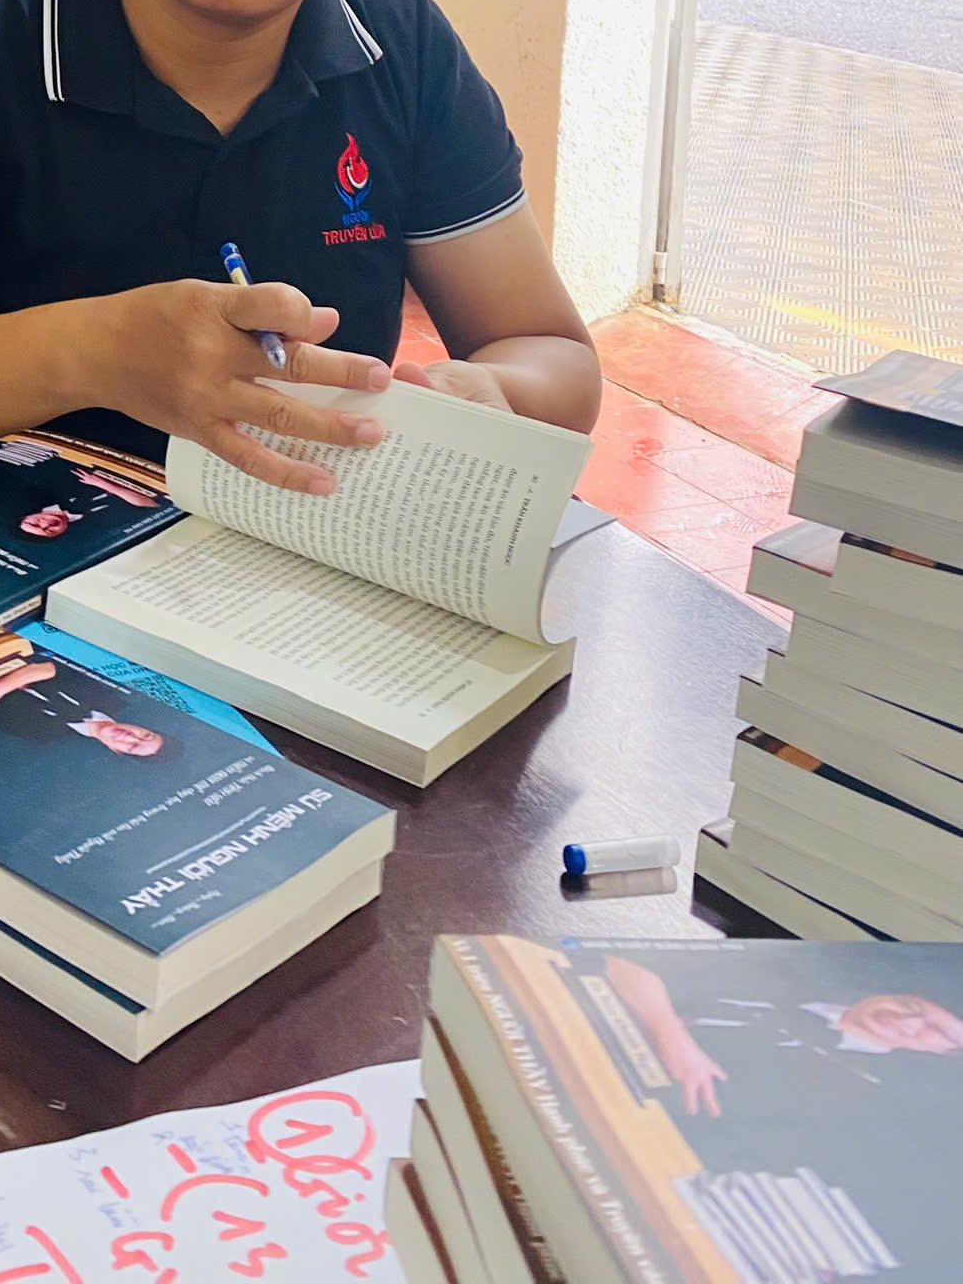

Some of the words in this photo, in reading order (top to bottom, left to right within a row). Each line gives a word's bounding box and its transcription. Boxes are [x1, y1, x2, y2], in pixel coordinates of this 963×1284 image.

[241, 804, 304, 844] MỆNH
[178, 841, 247, 880] NGƯỜI
[122, 877, 184, 914] THẦY
